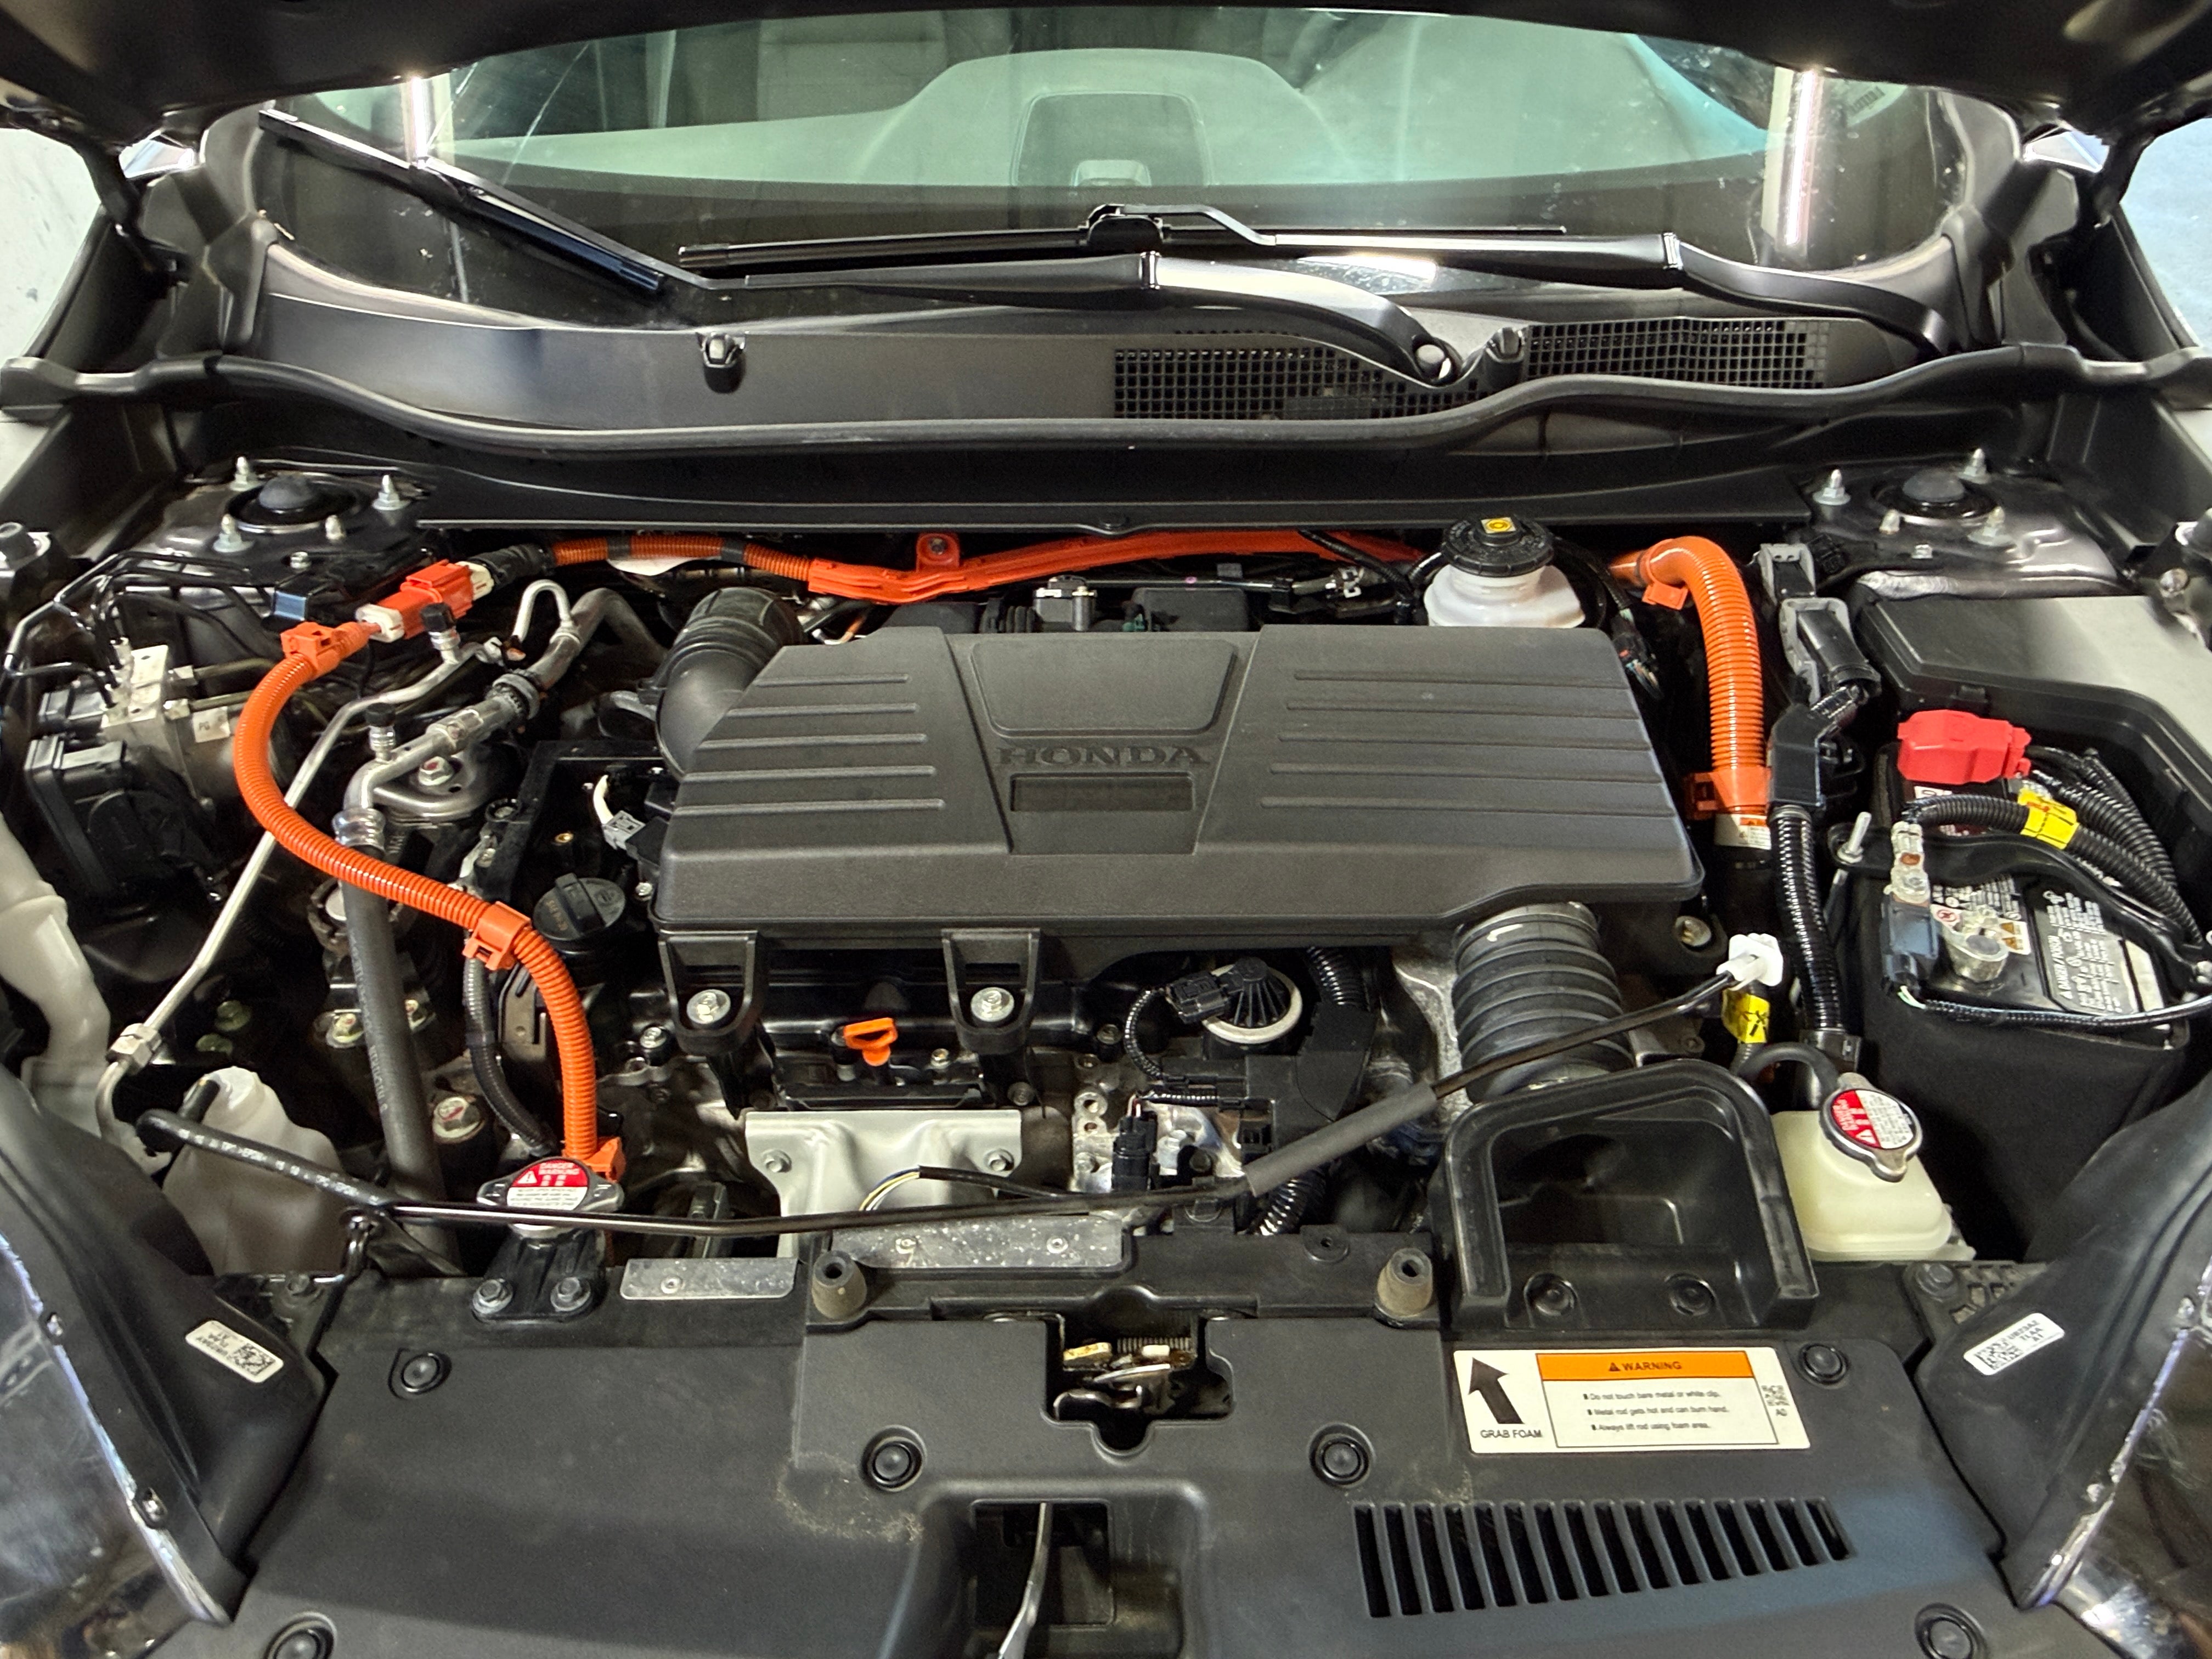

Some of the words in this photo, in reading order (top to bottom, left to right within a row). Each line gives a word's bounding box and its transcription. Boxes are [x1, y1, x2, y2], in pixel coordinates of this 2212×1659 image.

[996, 745, 1210, 766] HONDA
[1622, 1361, 1682, 1371] WARNING
[1480, 1430, 1510, 1438] GRAB
[1513, 1429, 1542, 1438] FOAM
